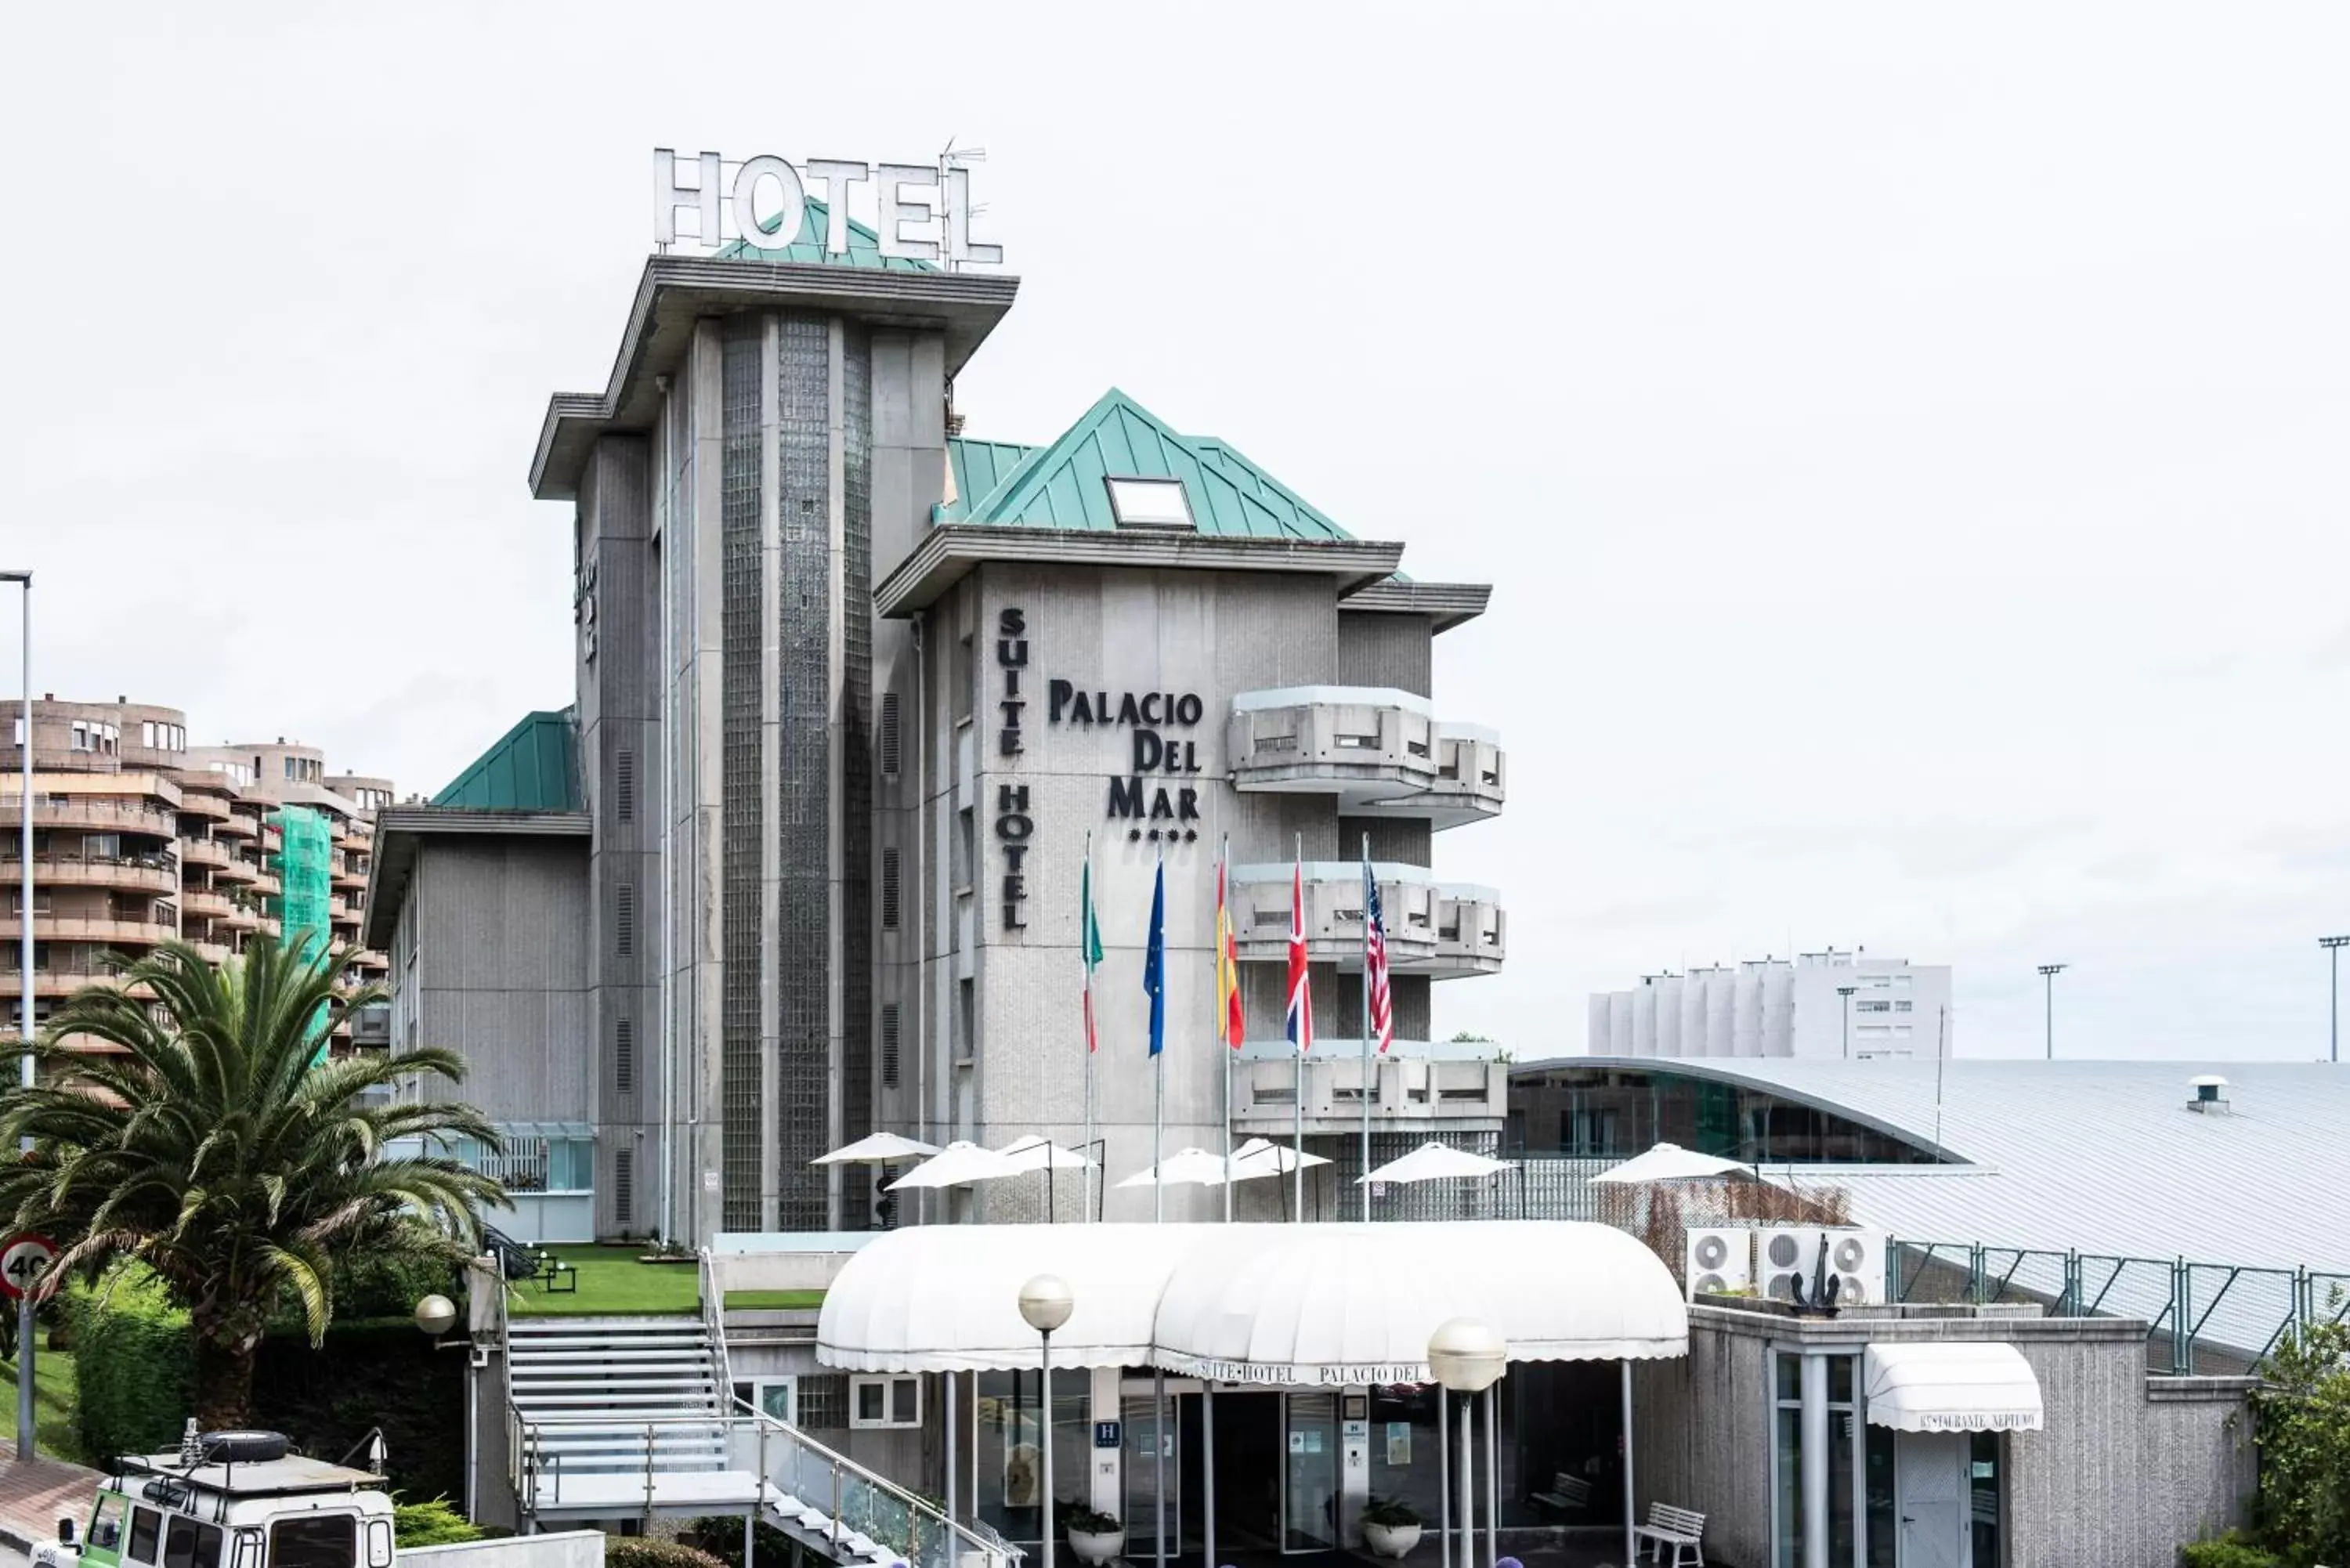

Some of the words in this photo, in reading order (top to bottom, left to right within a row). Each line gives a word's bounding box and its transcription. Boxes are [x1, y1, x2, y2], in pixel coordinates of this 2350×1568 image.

[654, 148, 1003, 263] HOTEL
[998, 608, 1029, 756] SUITE
[1049, 679, 1203, 726] PALACIO
[1133, 729, 1202, 773] DEL
[1108, 776, 1199, 820] MAR
[996, 784, 1034, 931] HOTEL
[1320, 1367, 1387, 1382] PALACIO
[1394, 1365, 1421, 1381] DEL
[1102, 1425, 1114, 1439] H
